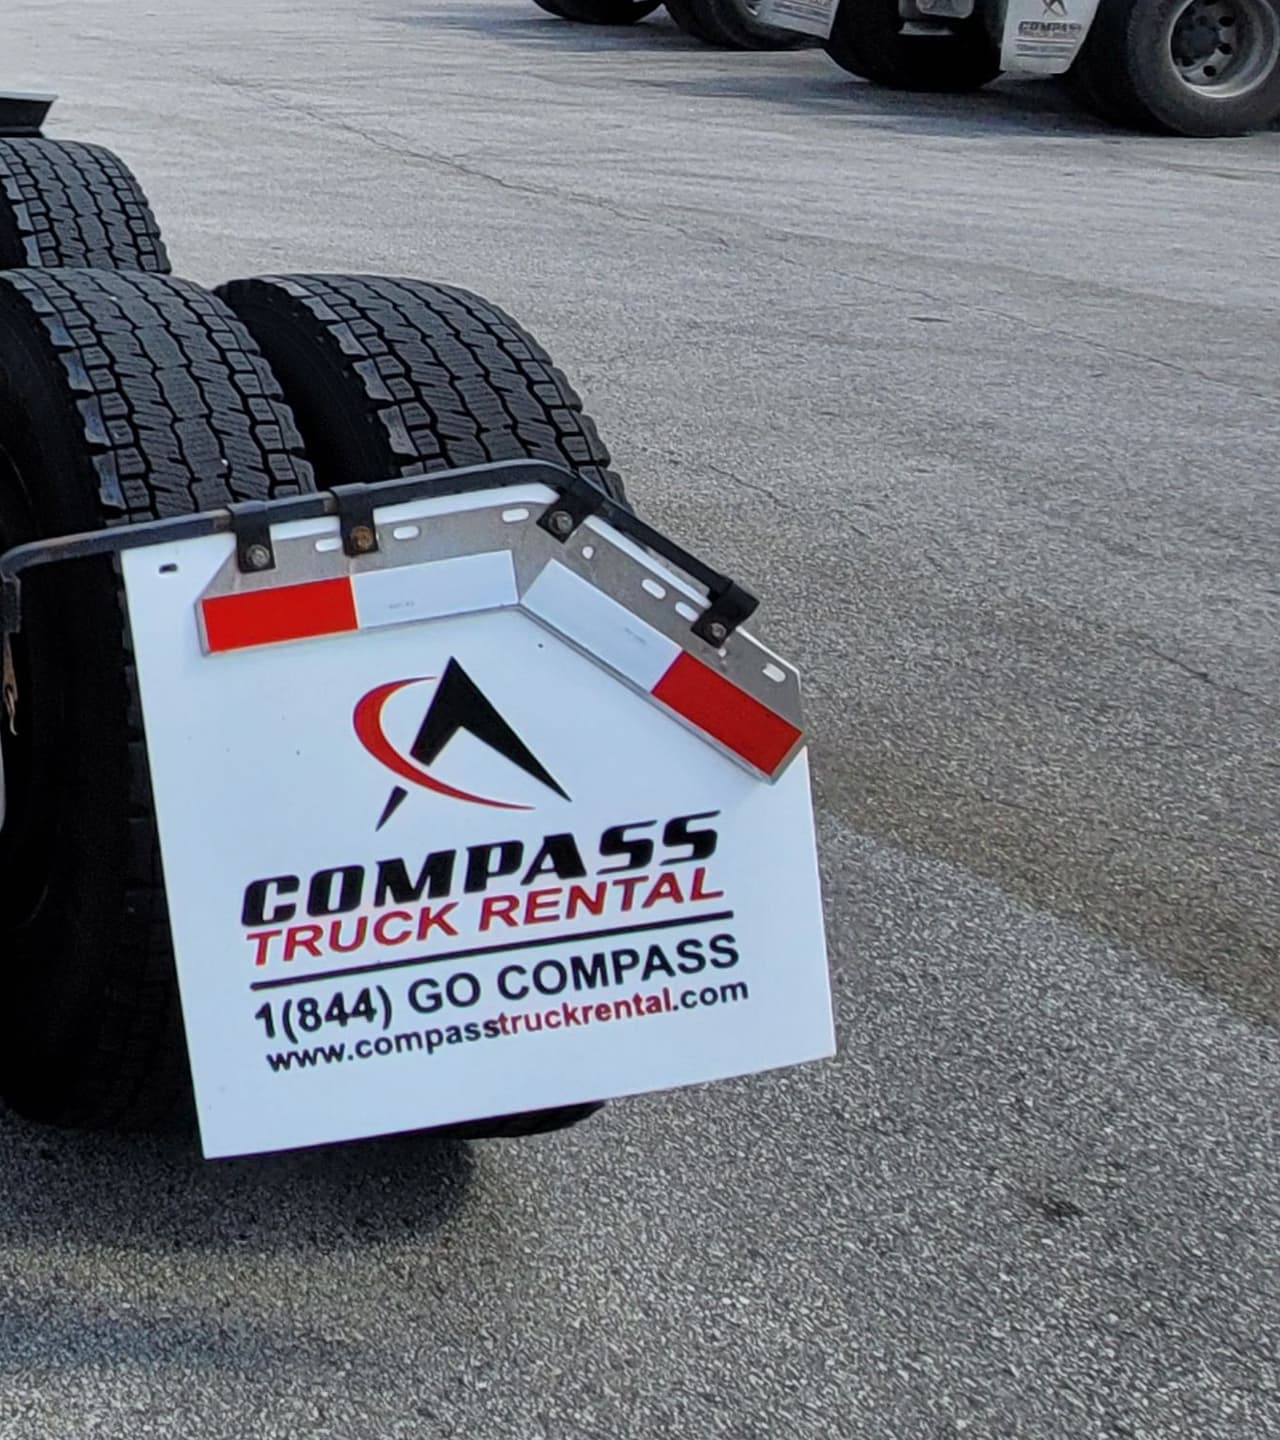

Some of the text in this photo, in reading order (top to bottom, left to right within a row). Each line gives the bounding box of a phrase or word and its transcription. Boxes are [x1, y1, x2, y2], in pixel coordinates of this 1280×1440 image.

[240, 809, 722, 928] COMPASS
[246, 867, 725, 966] TRUCK RENTAL
[254, 933, 740, 1045] 1(844) GO COMPASS
[266, 981, 750, 1073] www.compasstruckrental.com
